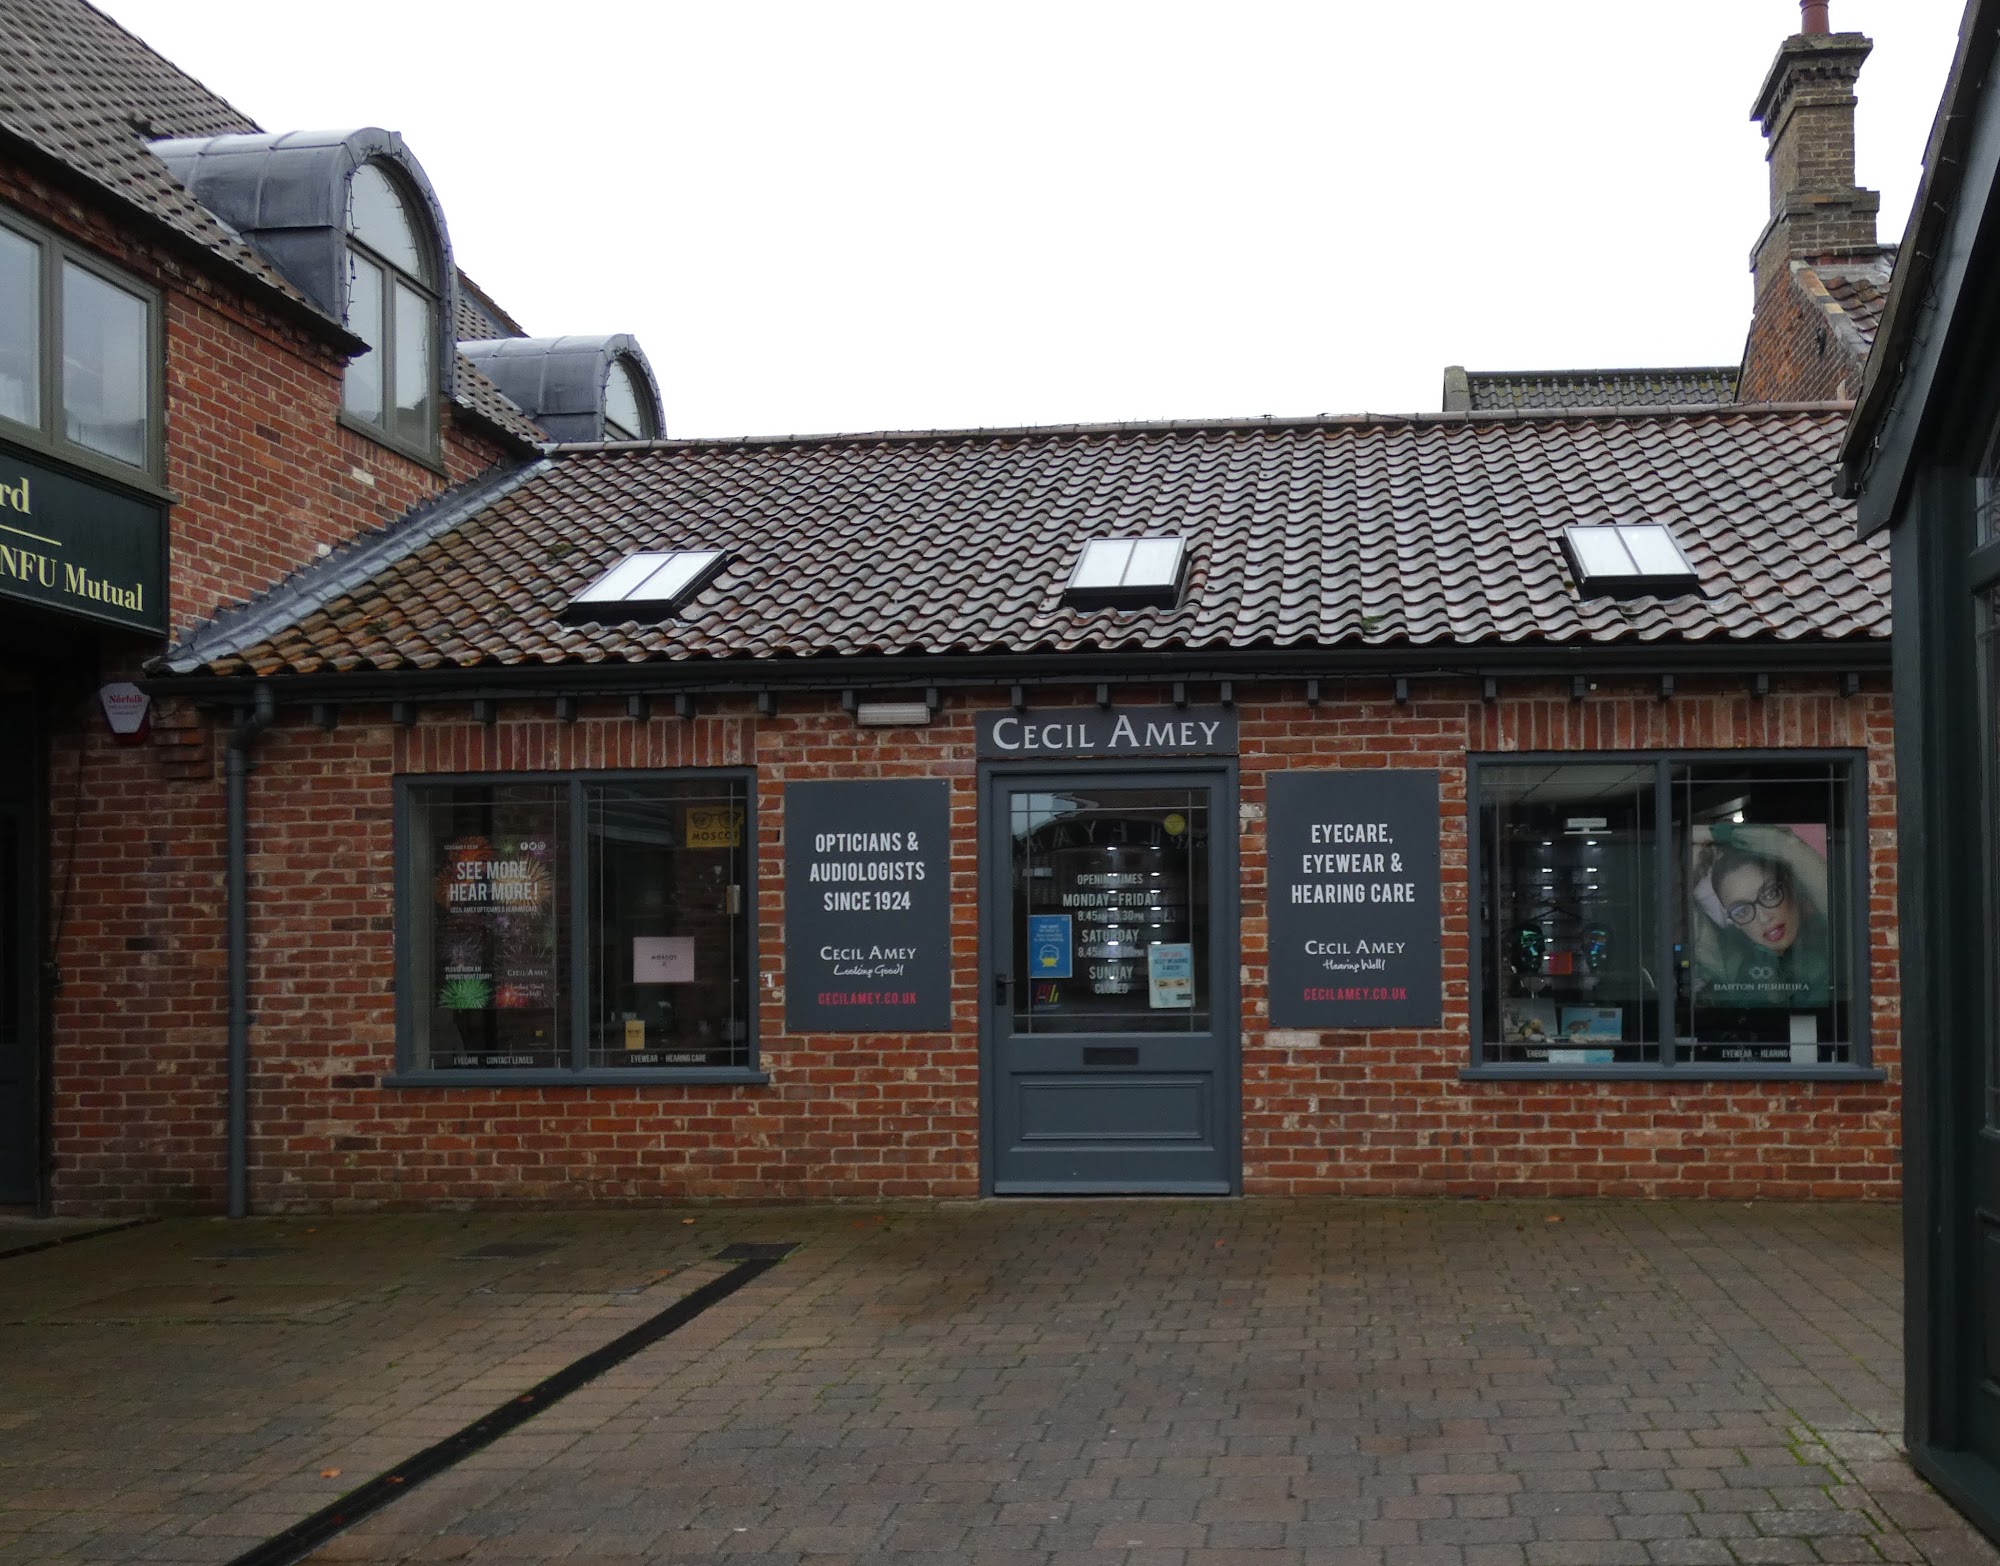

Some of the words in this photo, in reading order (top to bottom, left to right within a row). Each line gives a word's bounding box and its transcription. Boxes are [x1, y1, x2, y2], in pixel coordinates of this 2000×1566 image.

[0, 544, 57, 588] NFU
[64, 563, 144, 612] Mutual
[992, 717, 1095, 750] CECIL
[1107, 714, 1221, 747] AMEY
[815, 832, 901, 853] OPTICIANS
[907, 831, 919, 851] &
[1310, 823, 1394, 845] EYECARE,
[456, 861, 482, 880] SEE
[486, 861, 532, 880] MORE,
[1303, 853, 1385, 874] EYEWEAR
[1391, 852, 1403, 873] &
[809, 861, 926, 882] AUDIOLOGISTS
[1077, 873, 1115, 885] OPENIN
[449, 883, 487, 901] HEAR
[491, 882, 539, 901] MORE!
[1291, 883, 1366, 904] HEARING
[1370, 883, 1416, 903] CARE
[823, 891, 871, 911] SINCE
[874, 891, 912, 911] 1924
[1081, 929, 1140, 943] SATURDAY
[820, 945, 864, 961] CECIL
[869, 945, 917, 960] AMEY
[1304, 940, 1351, 955] CECIL
[1356, 939, 1406, 954] AMEY
[833, 964, 874, 978] Looking
[874, 963, 904, 977] Good!
[1088, 966, 1134, 980] SUNDAY
[1322, 959, 1360, 973] Hearing
[1360, 958, 1386, 971] Well!
[1303, 987, 1407, 1001] CECILAMEY.CO.UK
[1713, 983, 1754, 991] BARTON
[1758, 983, 1809, 991] PERREIRA
[818, 992, 917, 1005] CECILAMEY.CO.UK
[630, 1054, 659, 1063] EYEWEAR
[665, 1054, 691, 1063] HEARING
[691, 1054, 707, 1062] CARE
[1722, 1049, 1753, 1058] EYEWEAR
